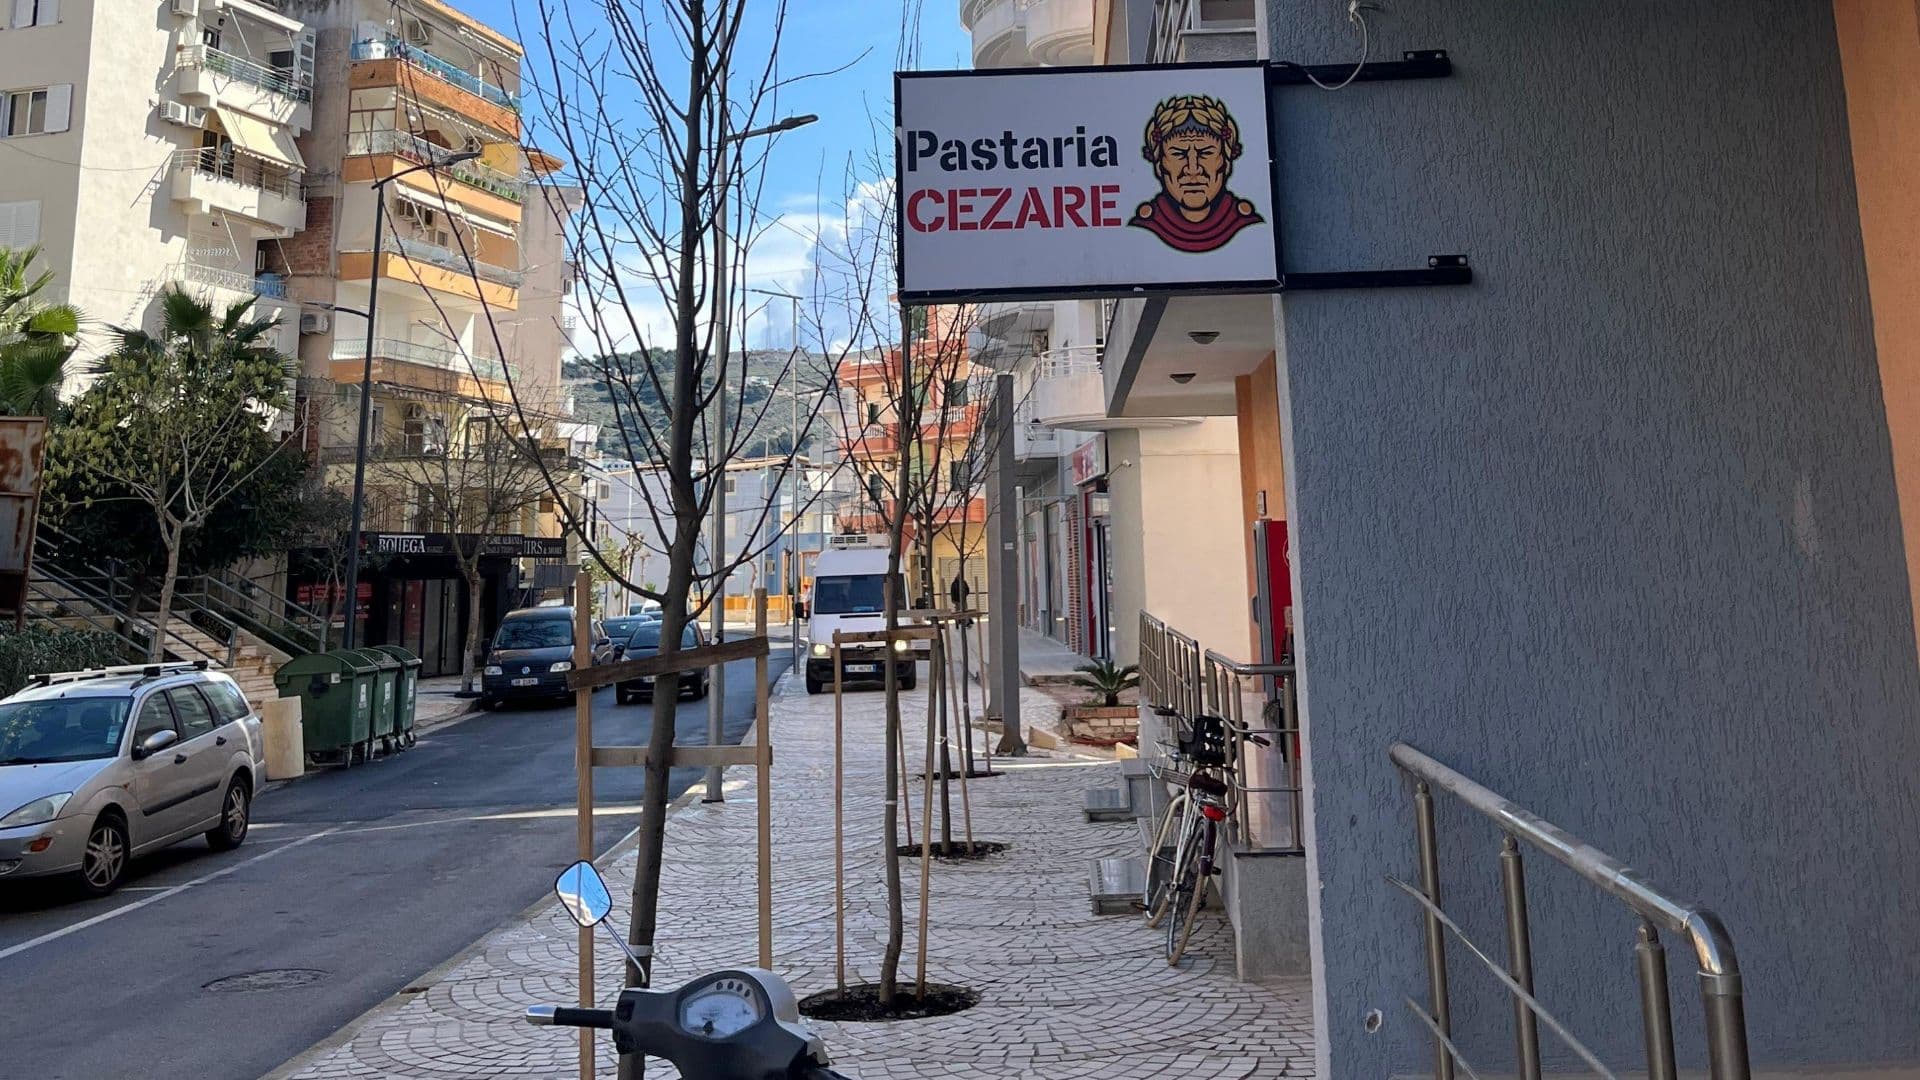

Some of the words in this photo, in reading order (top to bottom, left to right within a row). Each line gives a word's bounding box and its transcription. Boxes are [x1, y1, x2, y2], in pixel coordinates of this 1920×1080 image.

[907, 126, 1119, 172] Pastaria
[907, 184, 1122, 232] CEZARE
[378, 535, 425, 553] BOTTEGA
